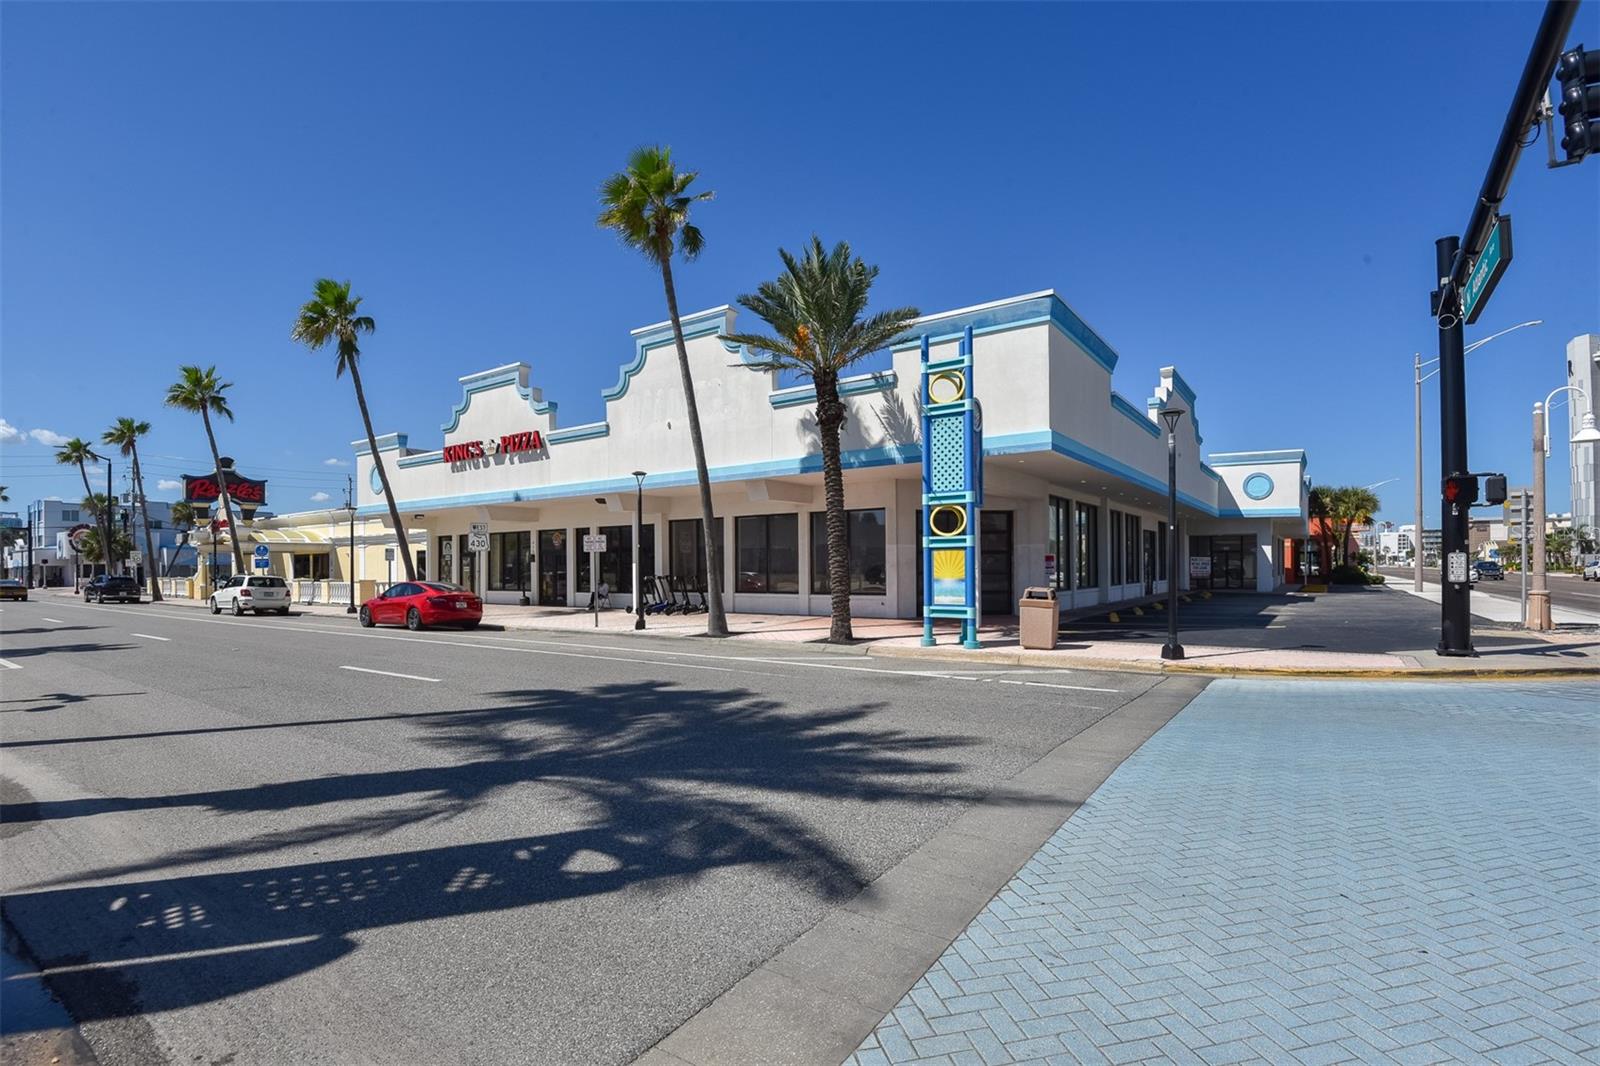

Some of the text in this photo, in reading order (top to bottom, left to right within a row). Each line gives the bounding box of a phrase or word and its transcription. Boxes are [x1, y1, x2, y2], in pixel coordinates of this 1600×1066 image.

[443, 430, 543, 463] KING'S PIZZA
[470, 539, 486, 547] 430
